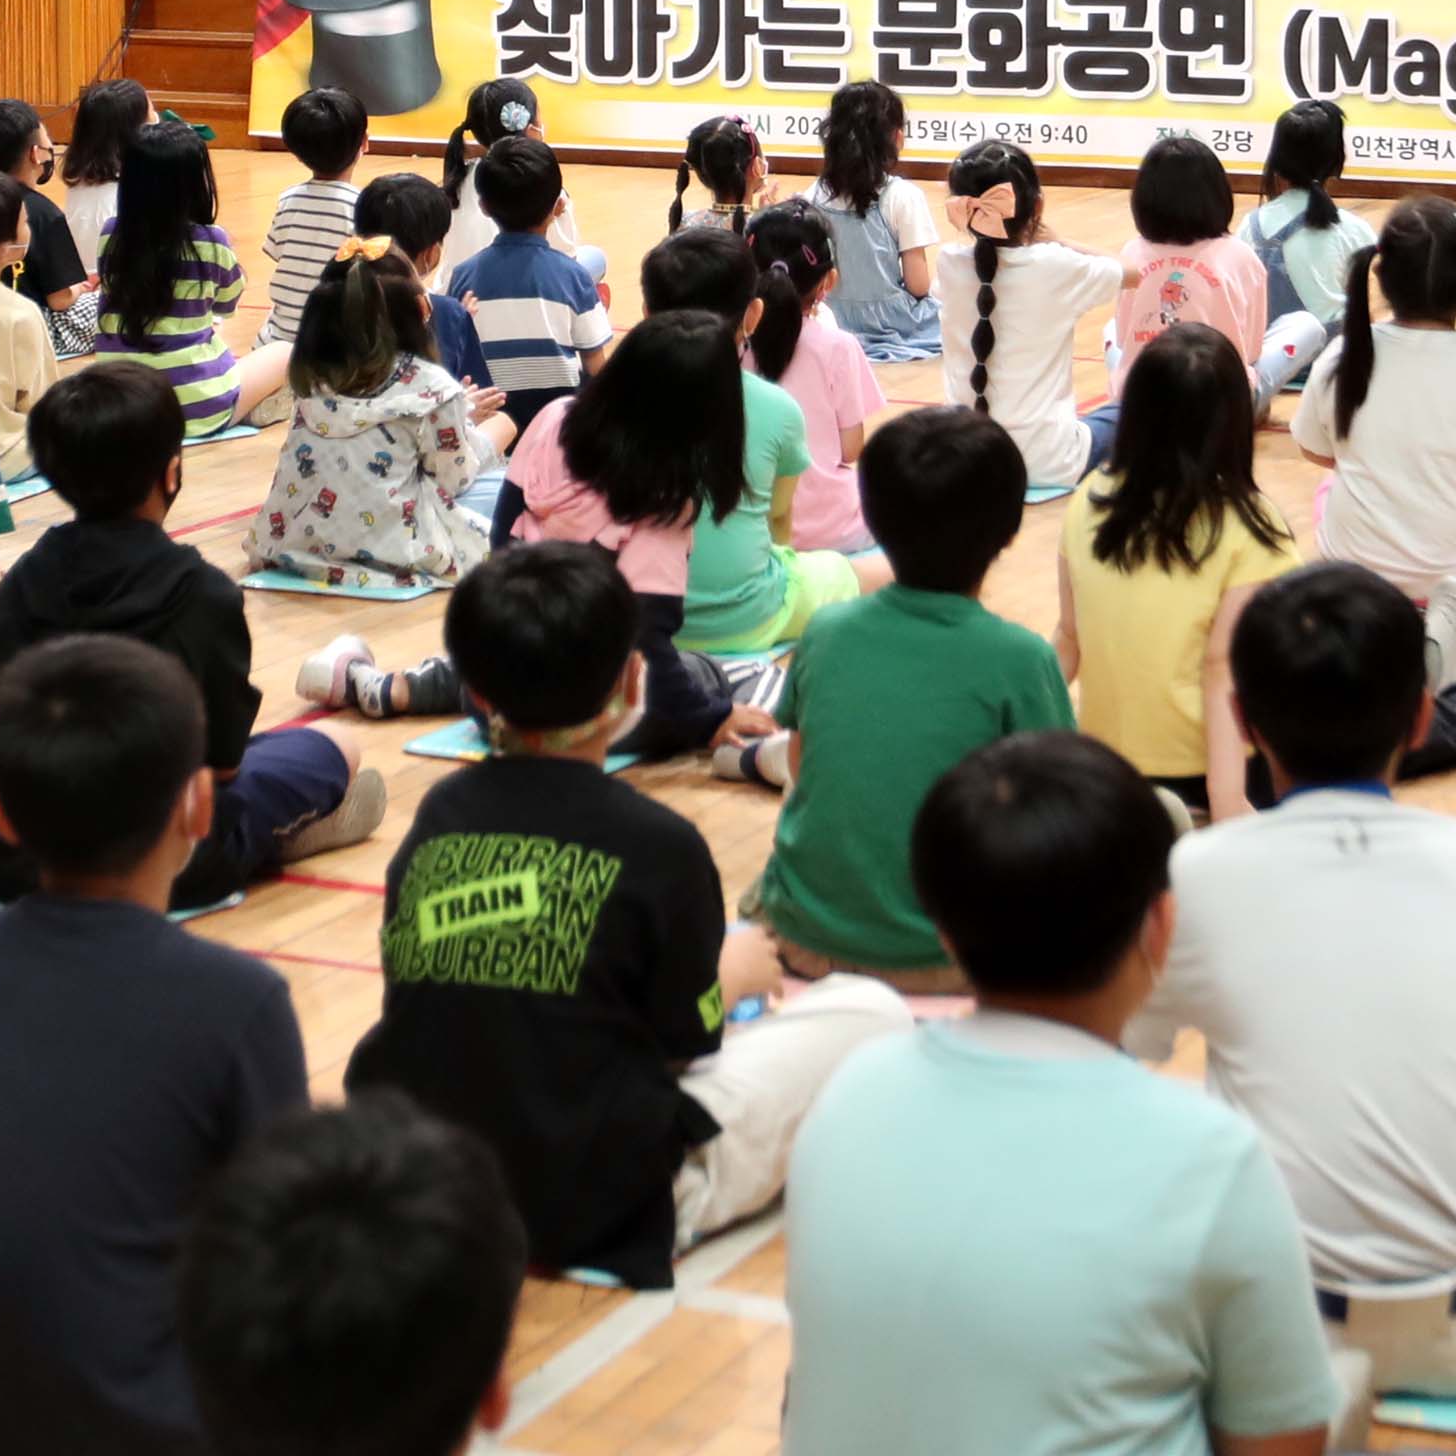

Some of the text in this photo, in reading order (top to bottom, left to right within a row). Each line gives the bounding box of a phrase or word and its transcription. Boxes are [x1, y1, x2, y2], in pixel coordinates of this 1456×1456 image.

[748, 114, 771, 135] 시
[784, 115, 824, 136] 202
[995, 122, 1032, 144] 오전
[1040, 124, 1088, 144] 9:40
[1212, 129, 1254, 152] 강당
[431, 882, 524, 928] TRAIN
